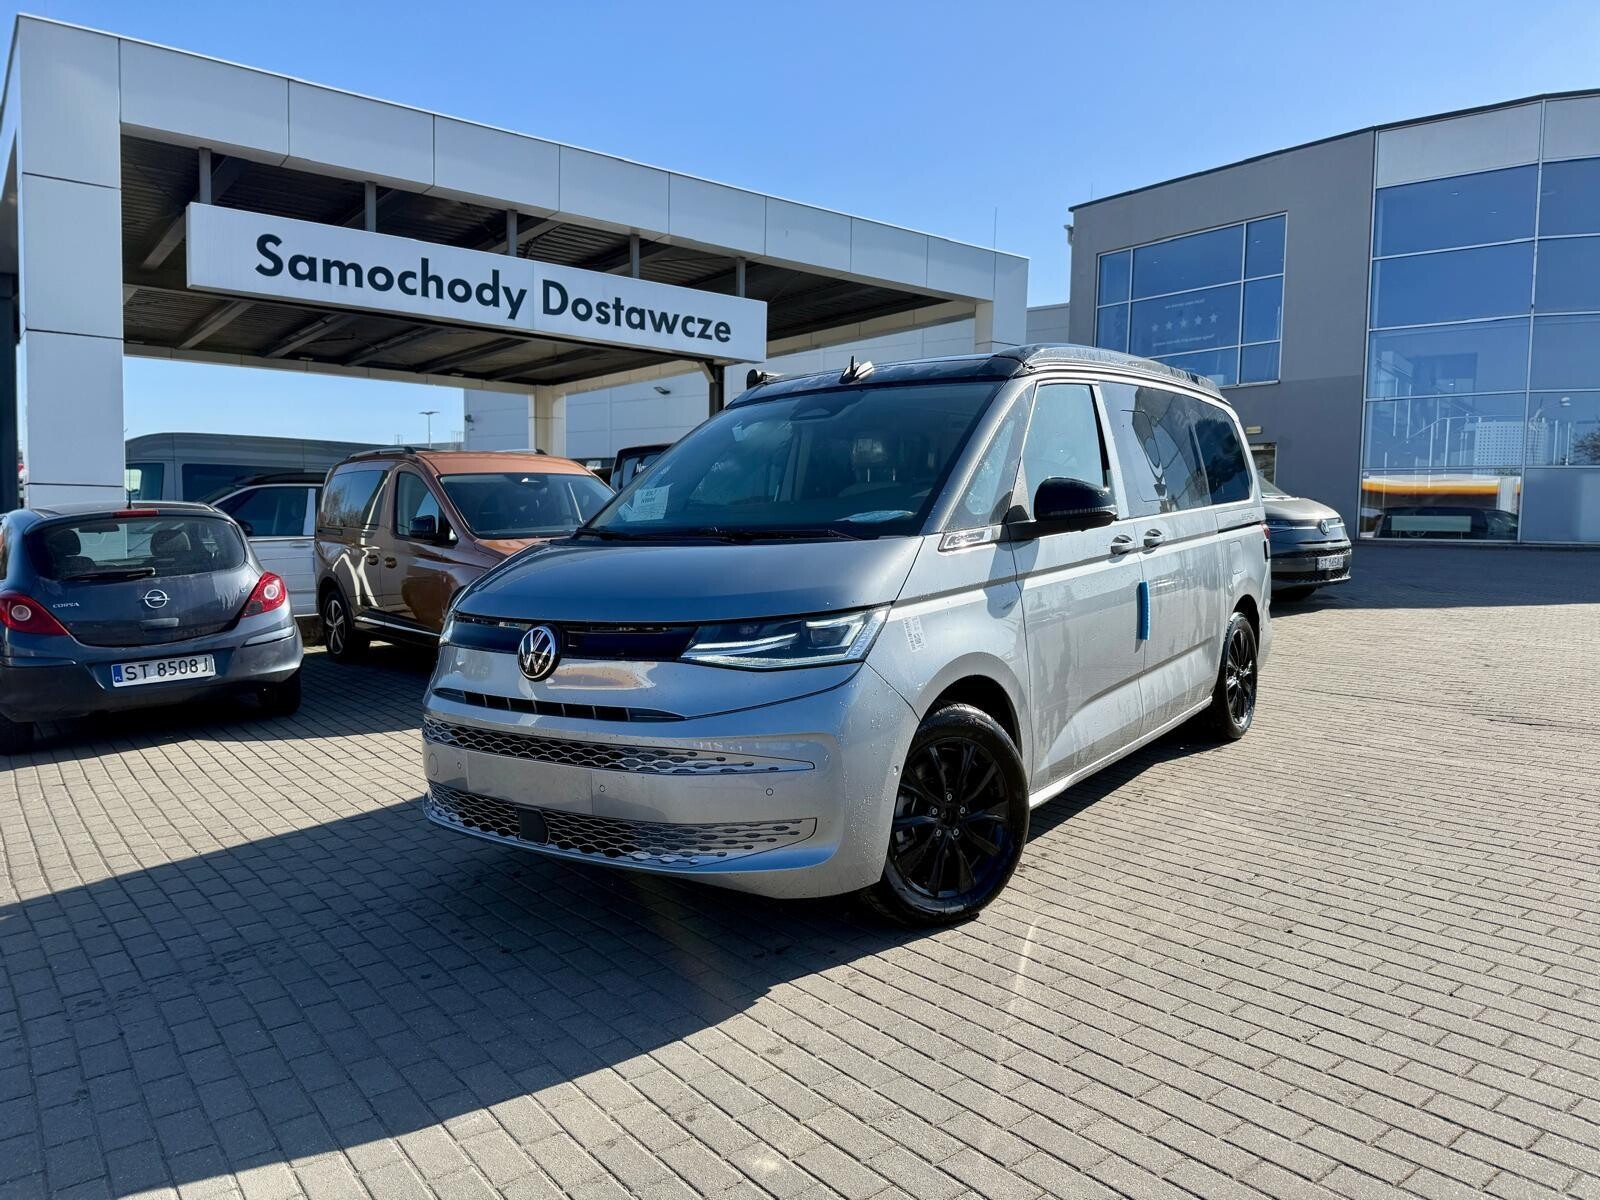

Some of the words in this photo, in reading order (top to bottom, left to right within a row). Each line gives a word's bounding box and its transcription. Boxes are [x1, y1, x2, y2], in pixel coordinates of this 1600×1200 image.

[255, 233, 528, 320] Samochody
[542, 279, 732, 343] Dostawcze
[125, 663, 149, 681] ST
[157, 657, 209, 677] 8508J
